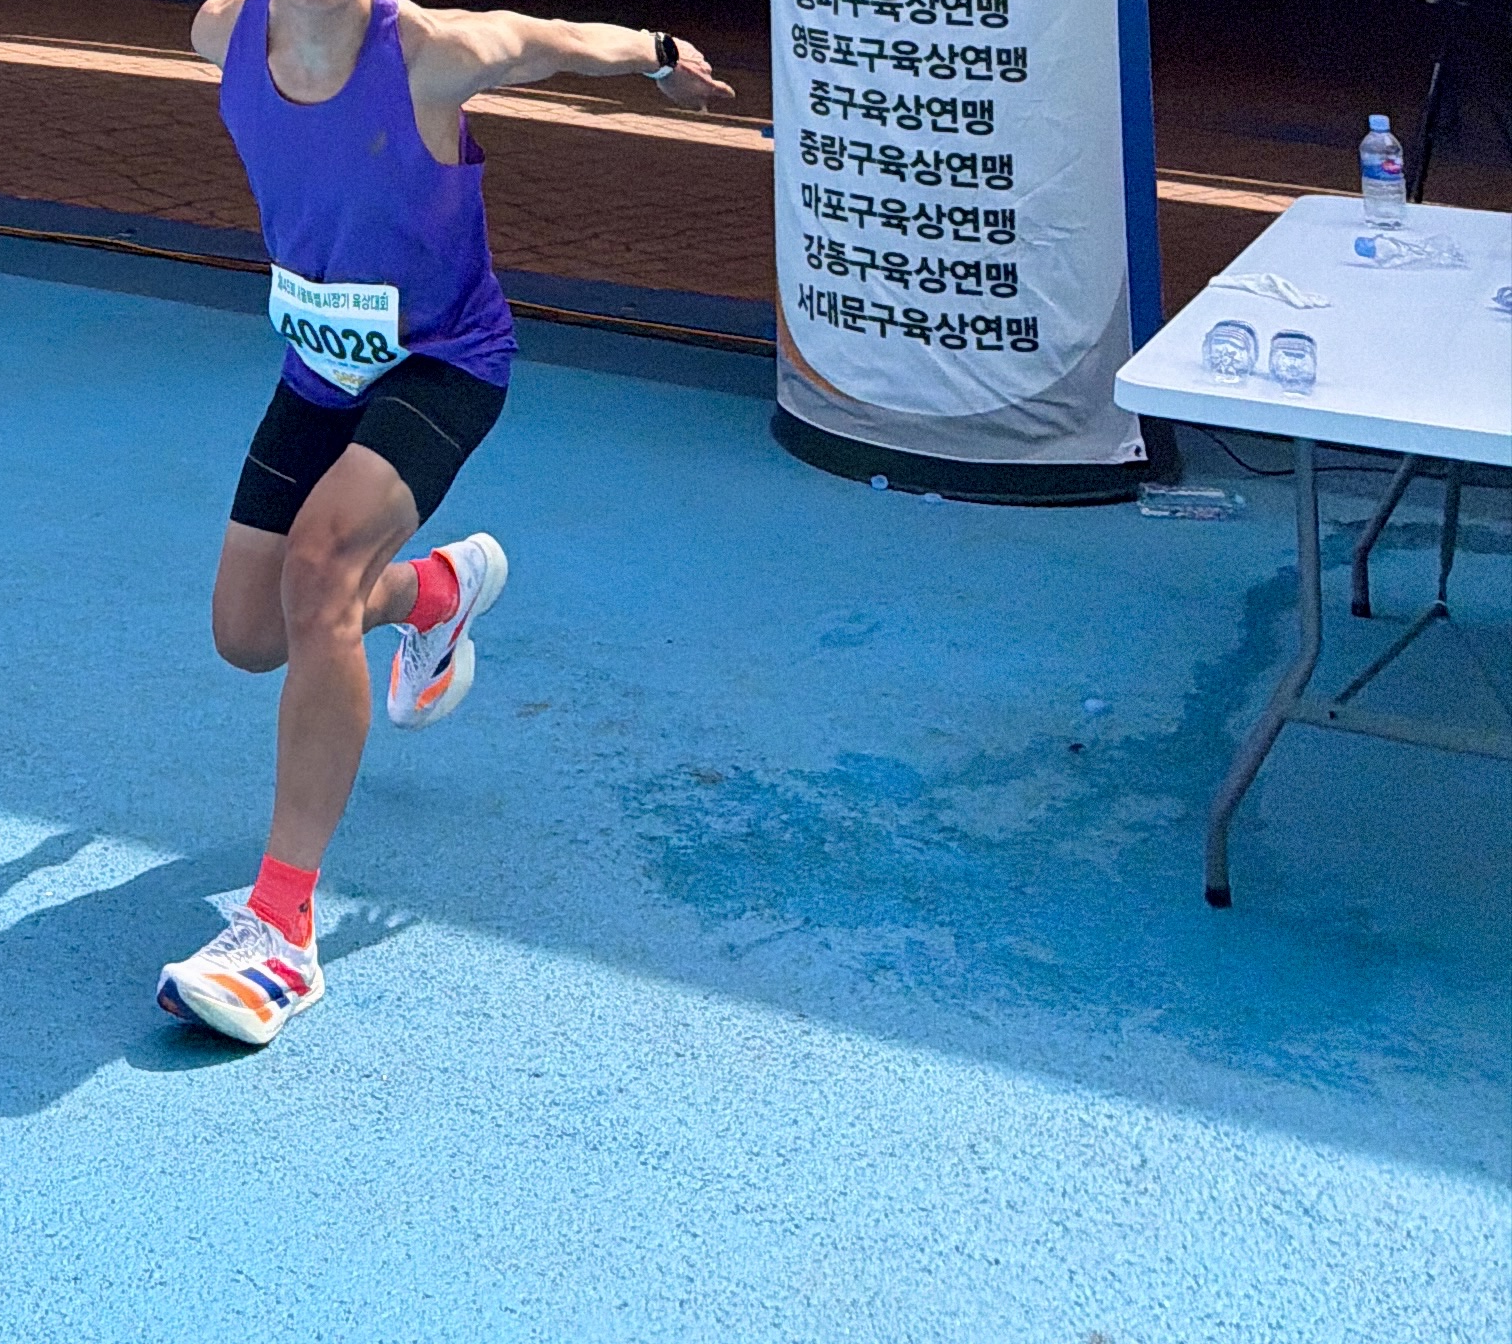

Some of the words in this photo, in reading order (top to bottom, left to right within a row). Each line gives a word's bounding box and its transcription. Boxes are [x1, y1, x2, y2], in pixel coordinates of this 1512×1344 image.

[791, 23, 1028, 83] 영등포구육상연맹
[809, 79, 995, 136] 중구육상연맹
[799, 128, 1013, 191] 중랑구육상연맹
[801, 182, 1016, 245] 마포구육상연맹
[803, 233, 1018, 298] 강동구육상연맹
[280, 313, 398, 364] 40028
[798, 283, 1039, 353] 서대문구육상연맹
